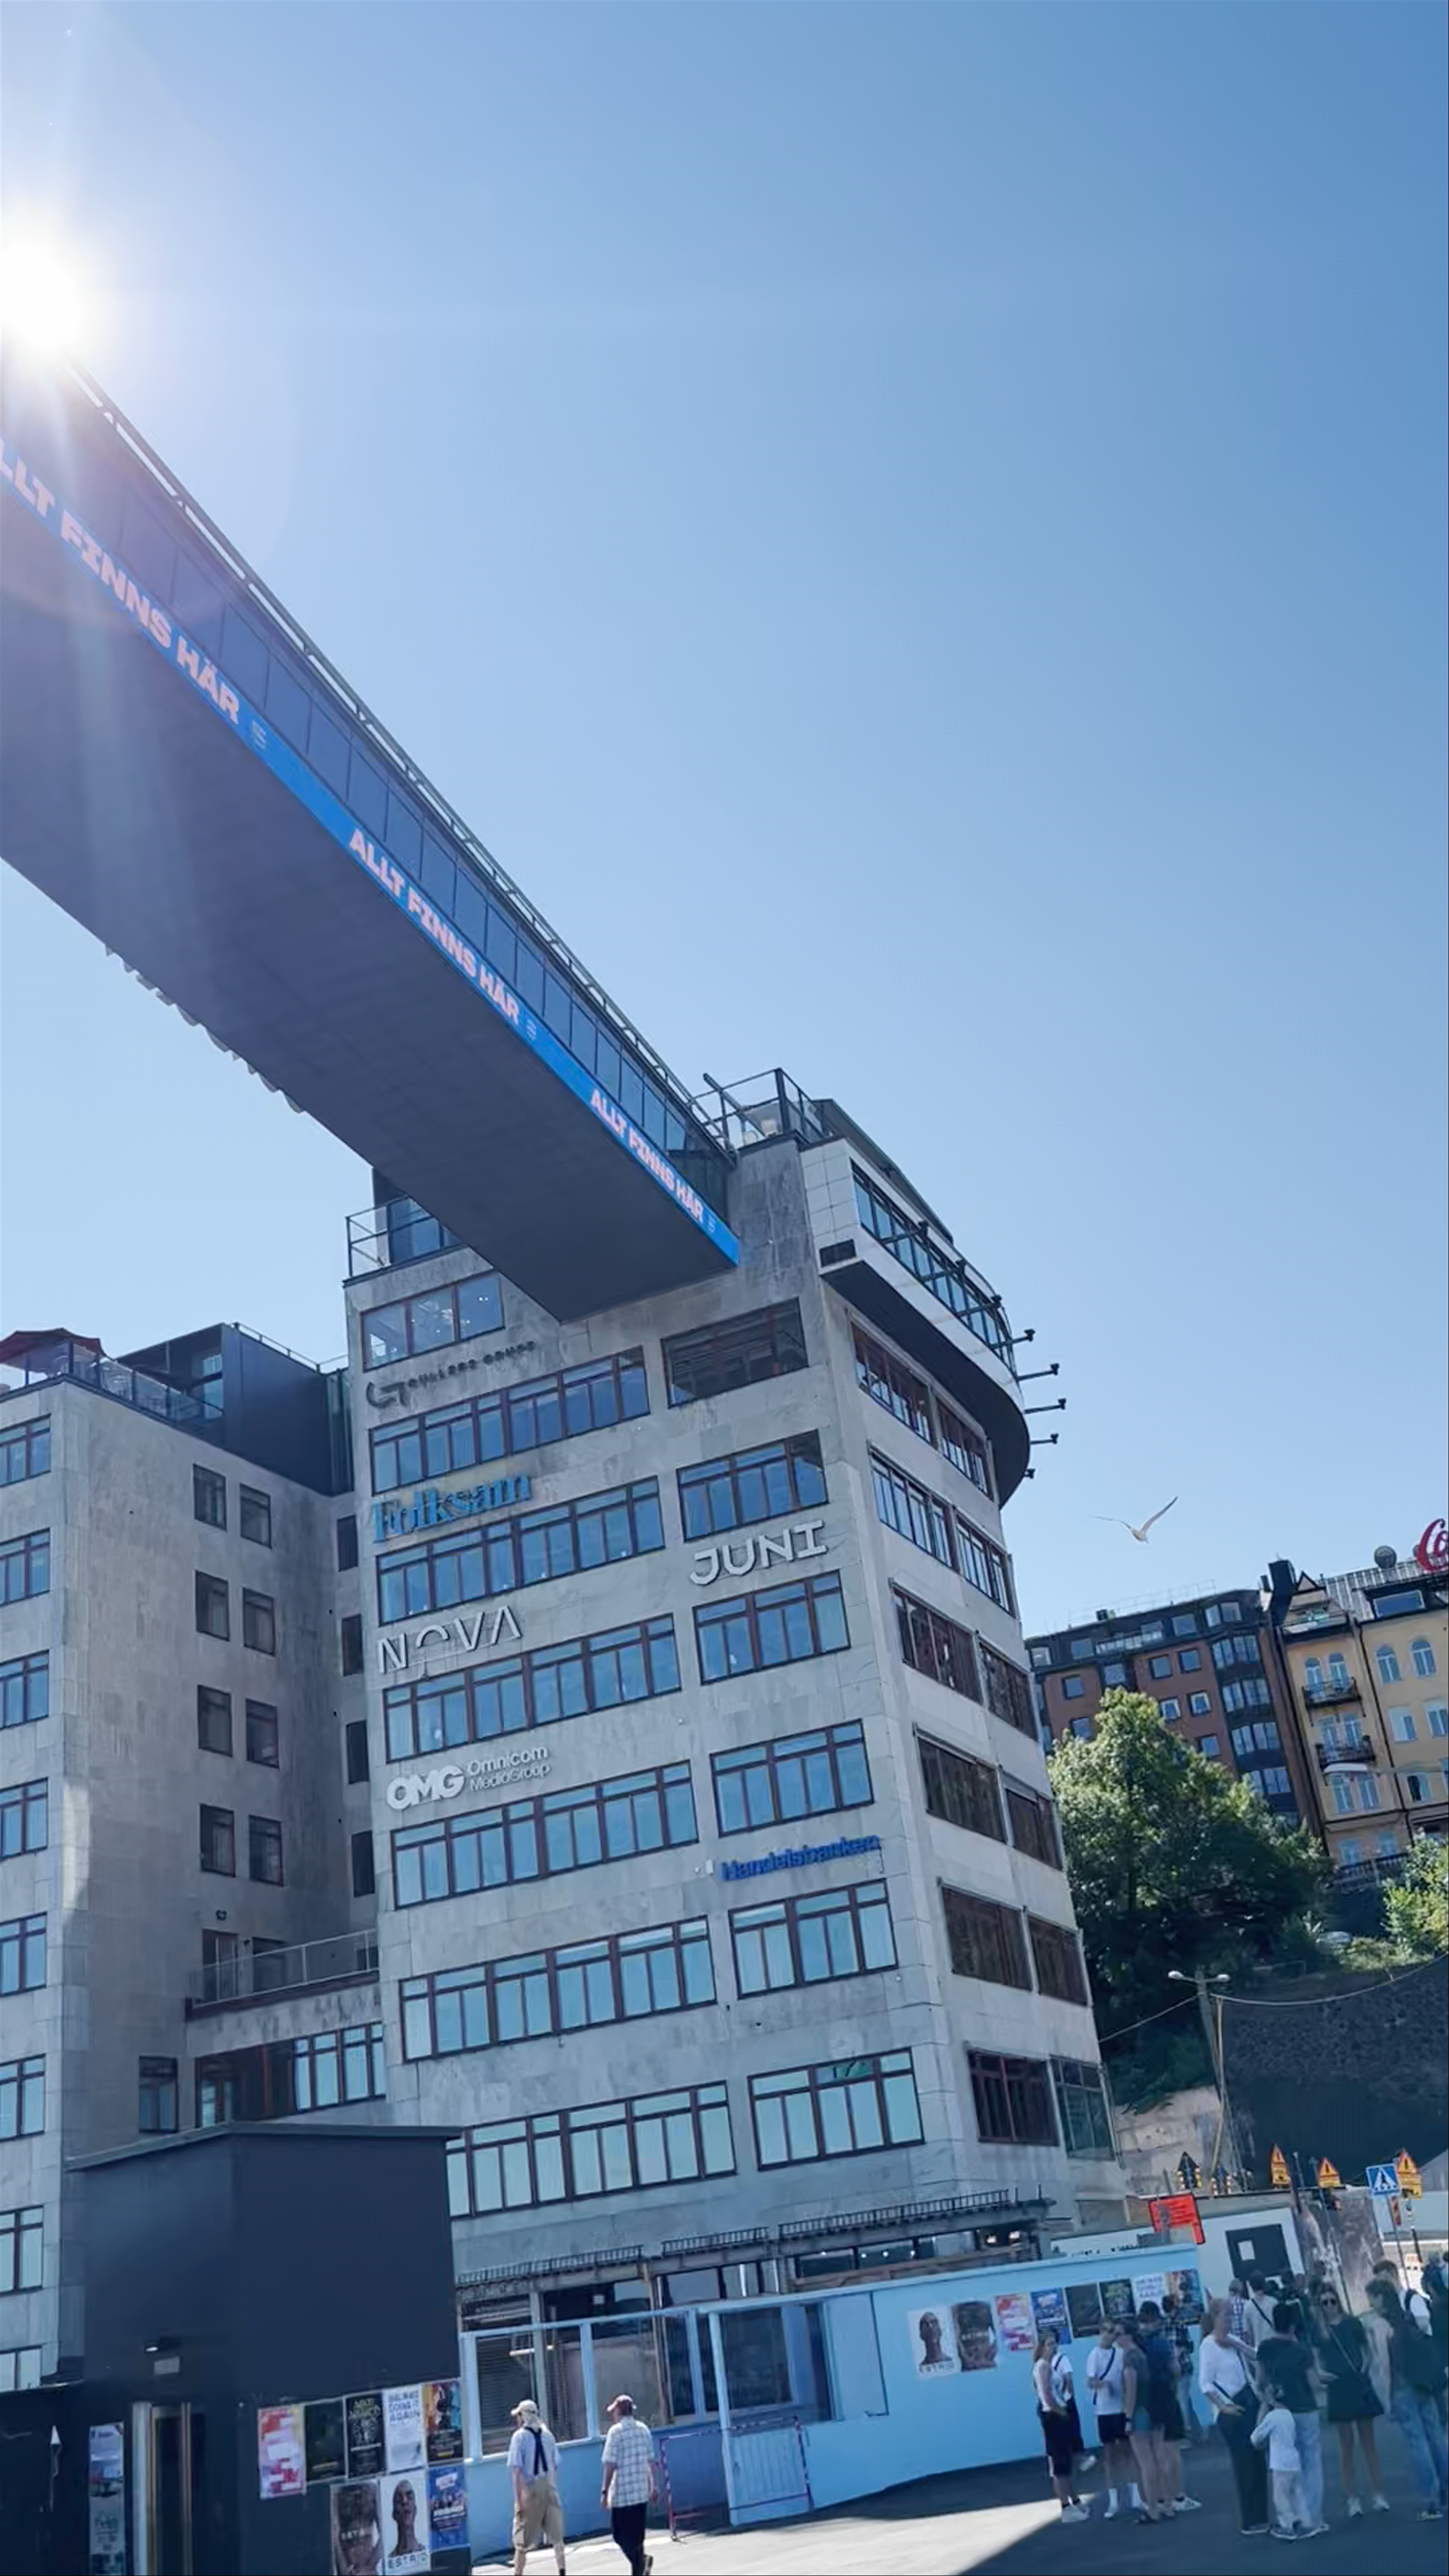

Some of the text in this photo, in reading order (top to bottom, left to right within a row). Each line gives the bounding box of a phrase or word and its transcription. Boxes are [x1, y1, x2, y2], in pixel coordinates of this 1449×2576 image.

[60, 509, 171, 648] FINNS
[177, 635, 239, 724] HÄR
[349, 828, 520, 1025] ALLT FINNS HÄR
[590, 1088, 628, 1138] ALLT
[629, 1126, 675, 1192] FINNS
[372, 1475, 532, 1543] Folksam
[689, 1519, 828, 1586] JUNI
[387, 1765, 465, 1810] OMG
[467, 1747, 549, 1776] Omnicom
[719, 1835, 881, 1881] Handelsbanken
